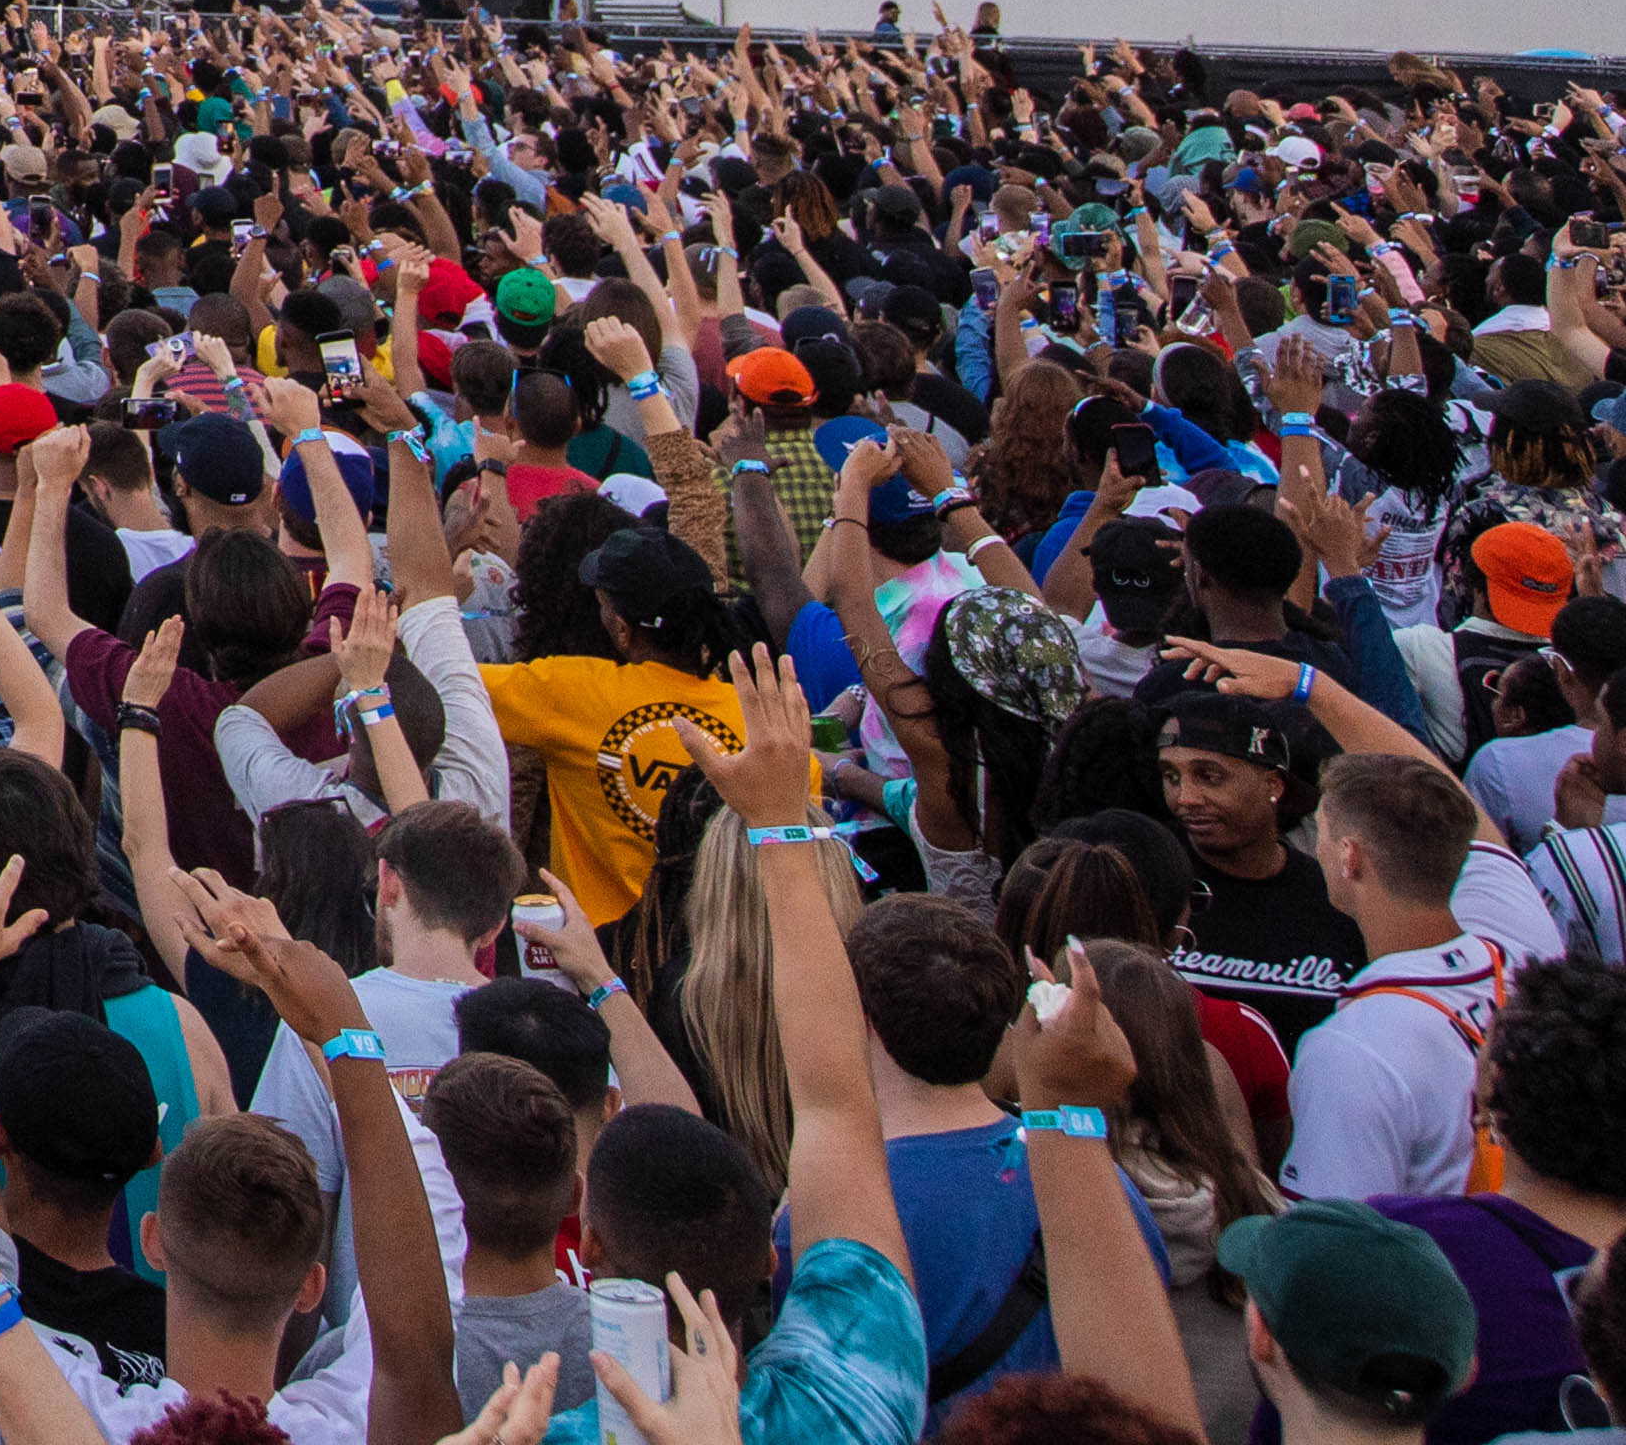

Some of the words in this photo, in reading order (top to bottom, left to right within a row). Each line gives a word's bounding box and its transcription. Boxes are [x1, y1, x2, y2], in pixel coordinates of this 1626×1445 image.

[629, 754, 693, 791] VA
[1172, 947, 1346, 991] reamville
[351, 1034, 376, 1054] GA
[1071, 1112, 1095, 1133] GA
